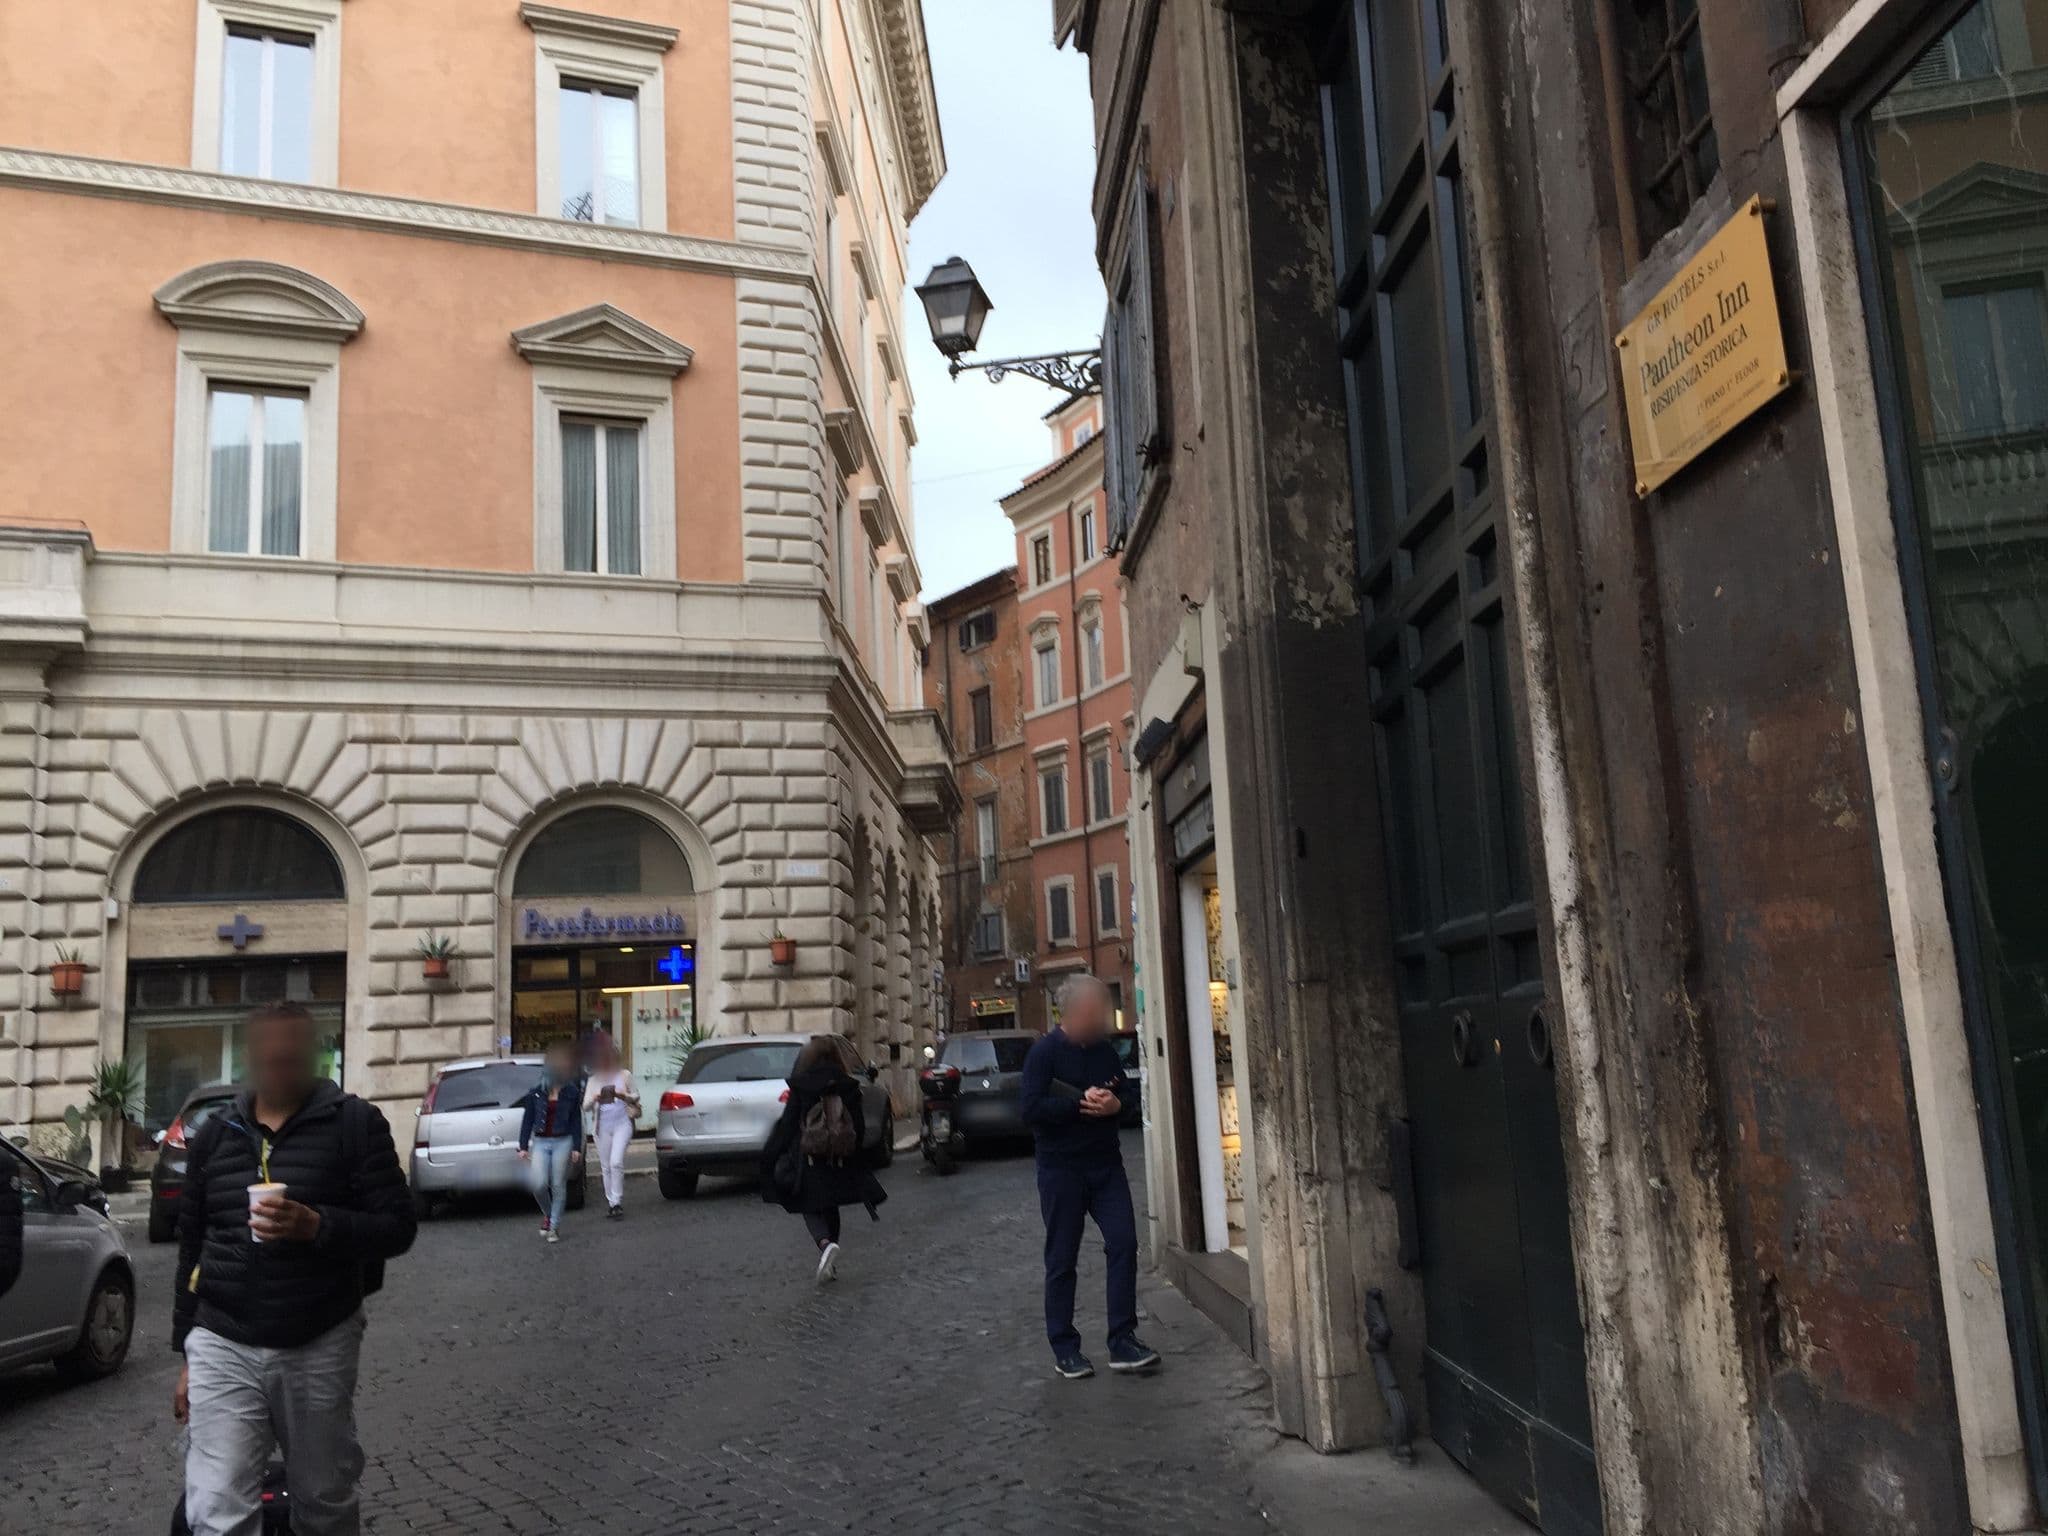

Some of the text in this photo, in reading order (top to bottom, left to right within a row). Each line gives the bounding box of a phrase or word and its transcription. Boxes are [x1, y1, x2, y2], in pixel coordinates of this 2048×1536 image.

[1640, 281, 1750, 396] Pantheon Inn
[1662, 266, 1705, 320] HOTELS
[1650, 363, 1702, 419] RESIDENZA
[1703, 323, 1748, 374] STORICA
